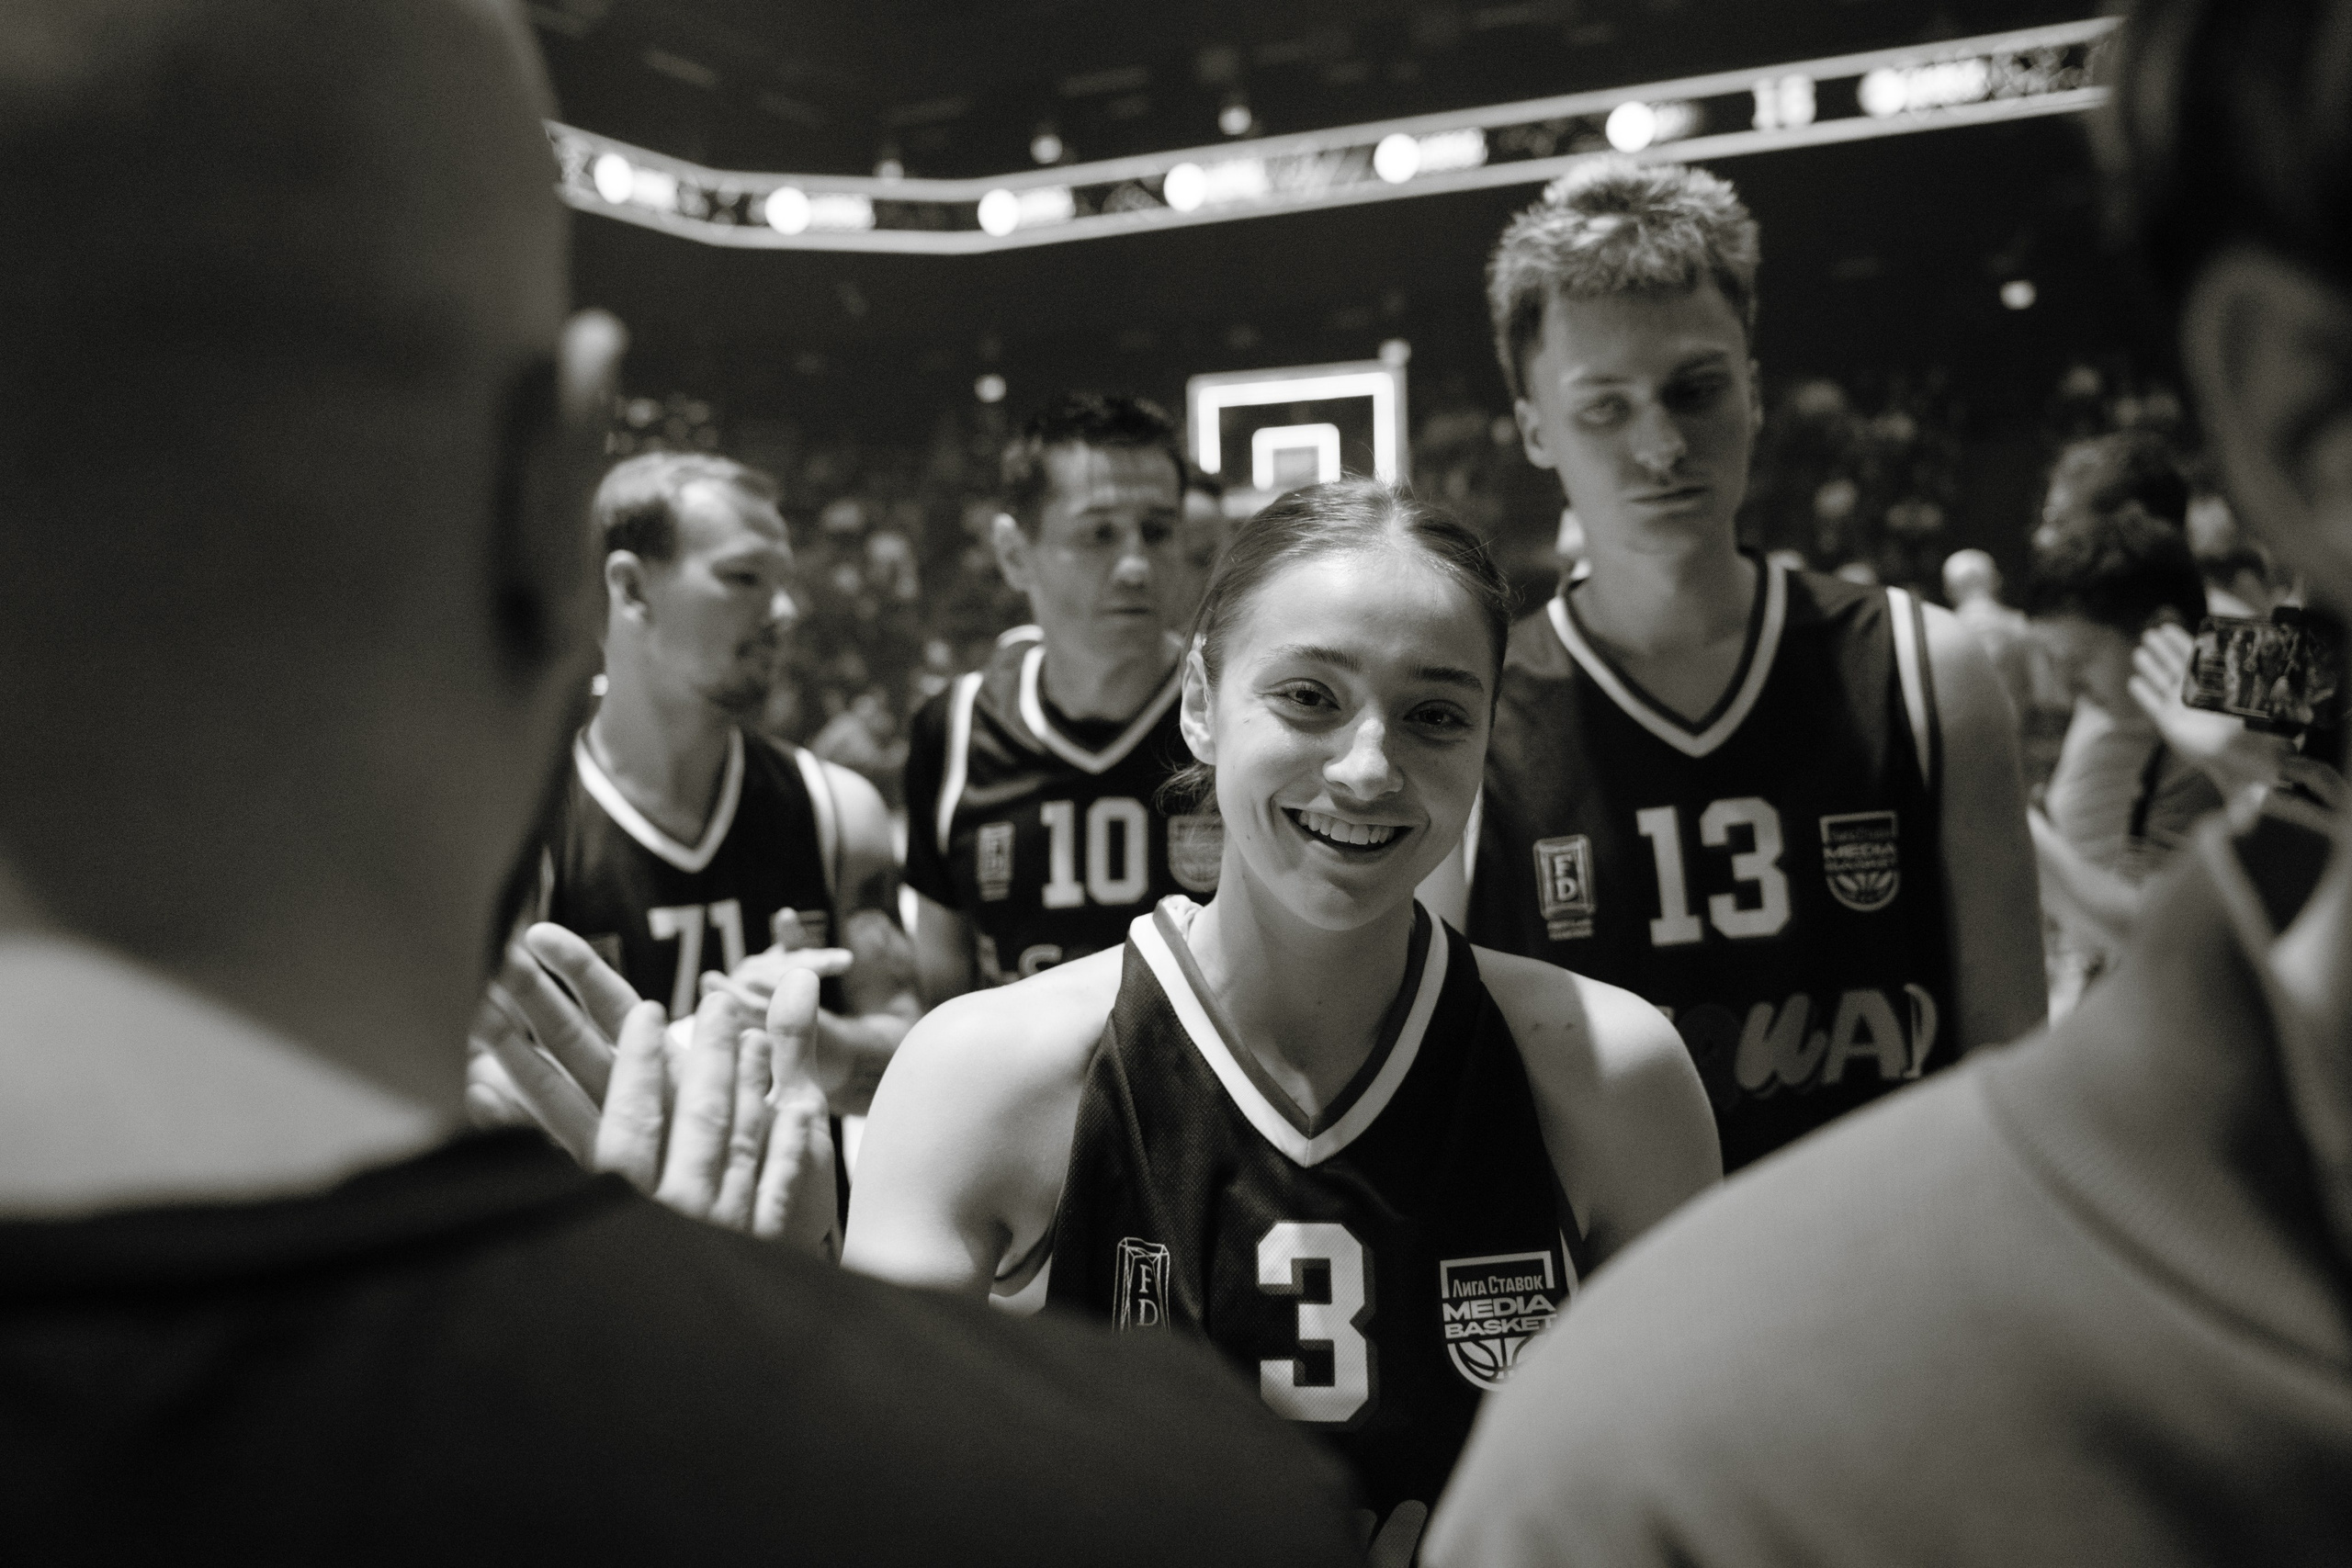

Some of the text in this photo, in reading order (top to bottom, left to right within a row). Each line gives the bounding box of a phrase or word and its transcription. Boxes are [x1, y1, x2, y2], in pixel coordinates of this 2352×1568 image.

[1040, 795, 1149, 909] 10
[1635, 795, 1792, 947] 13
[648, 897, 747, 1020] 71
[1257, 1222, 1373, 1425] 3
[1442, 1293, 1556, 1322] MEDIA
[1444, 1314, 1557, 1339] BASKET
